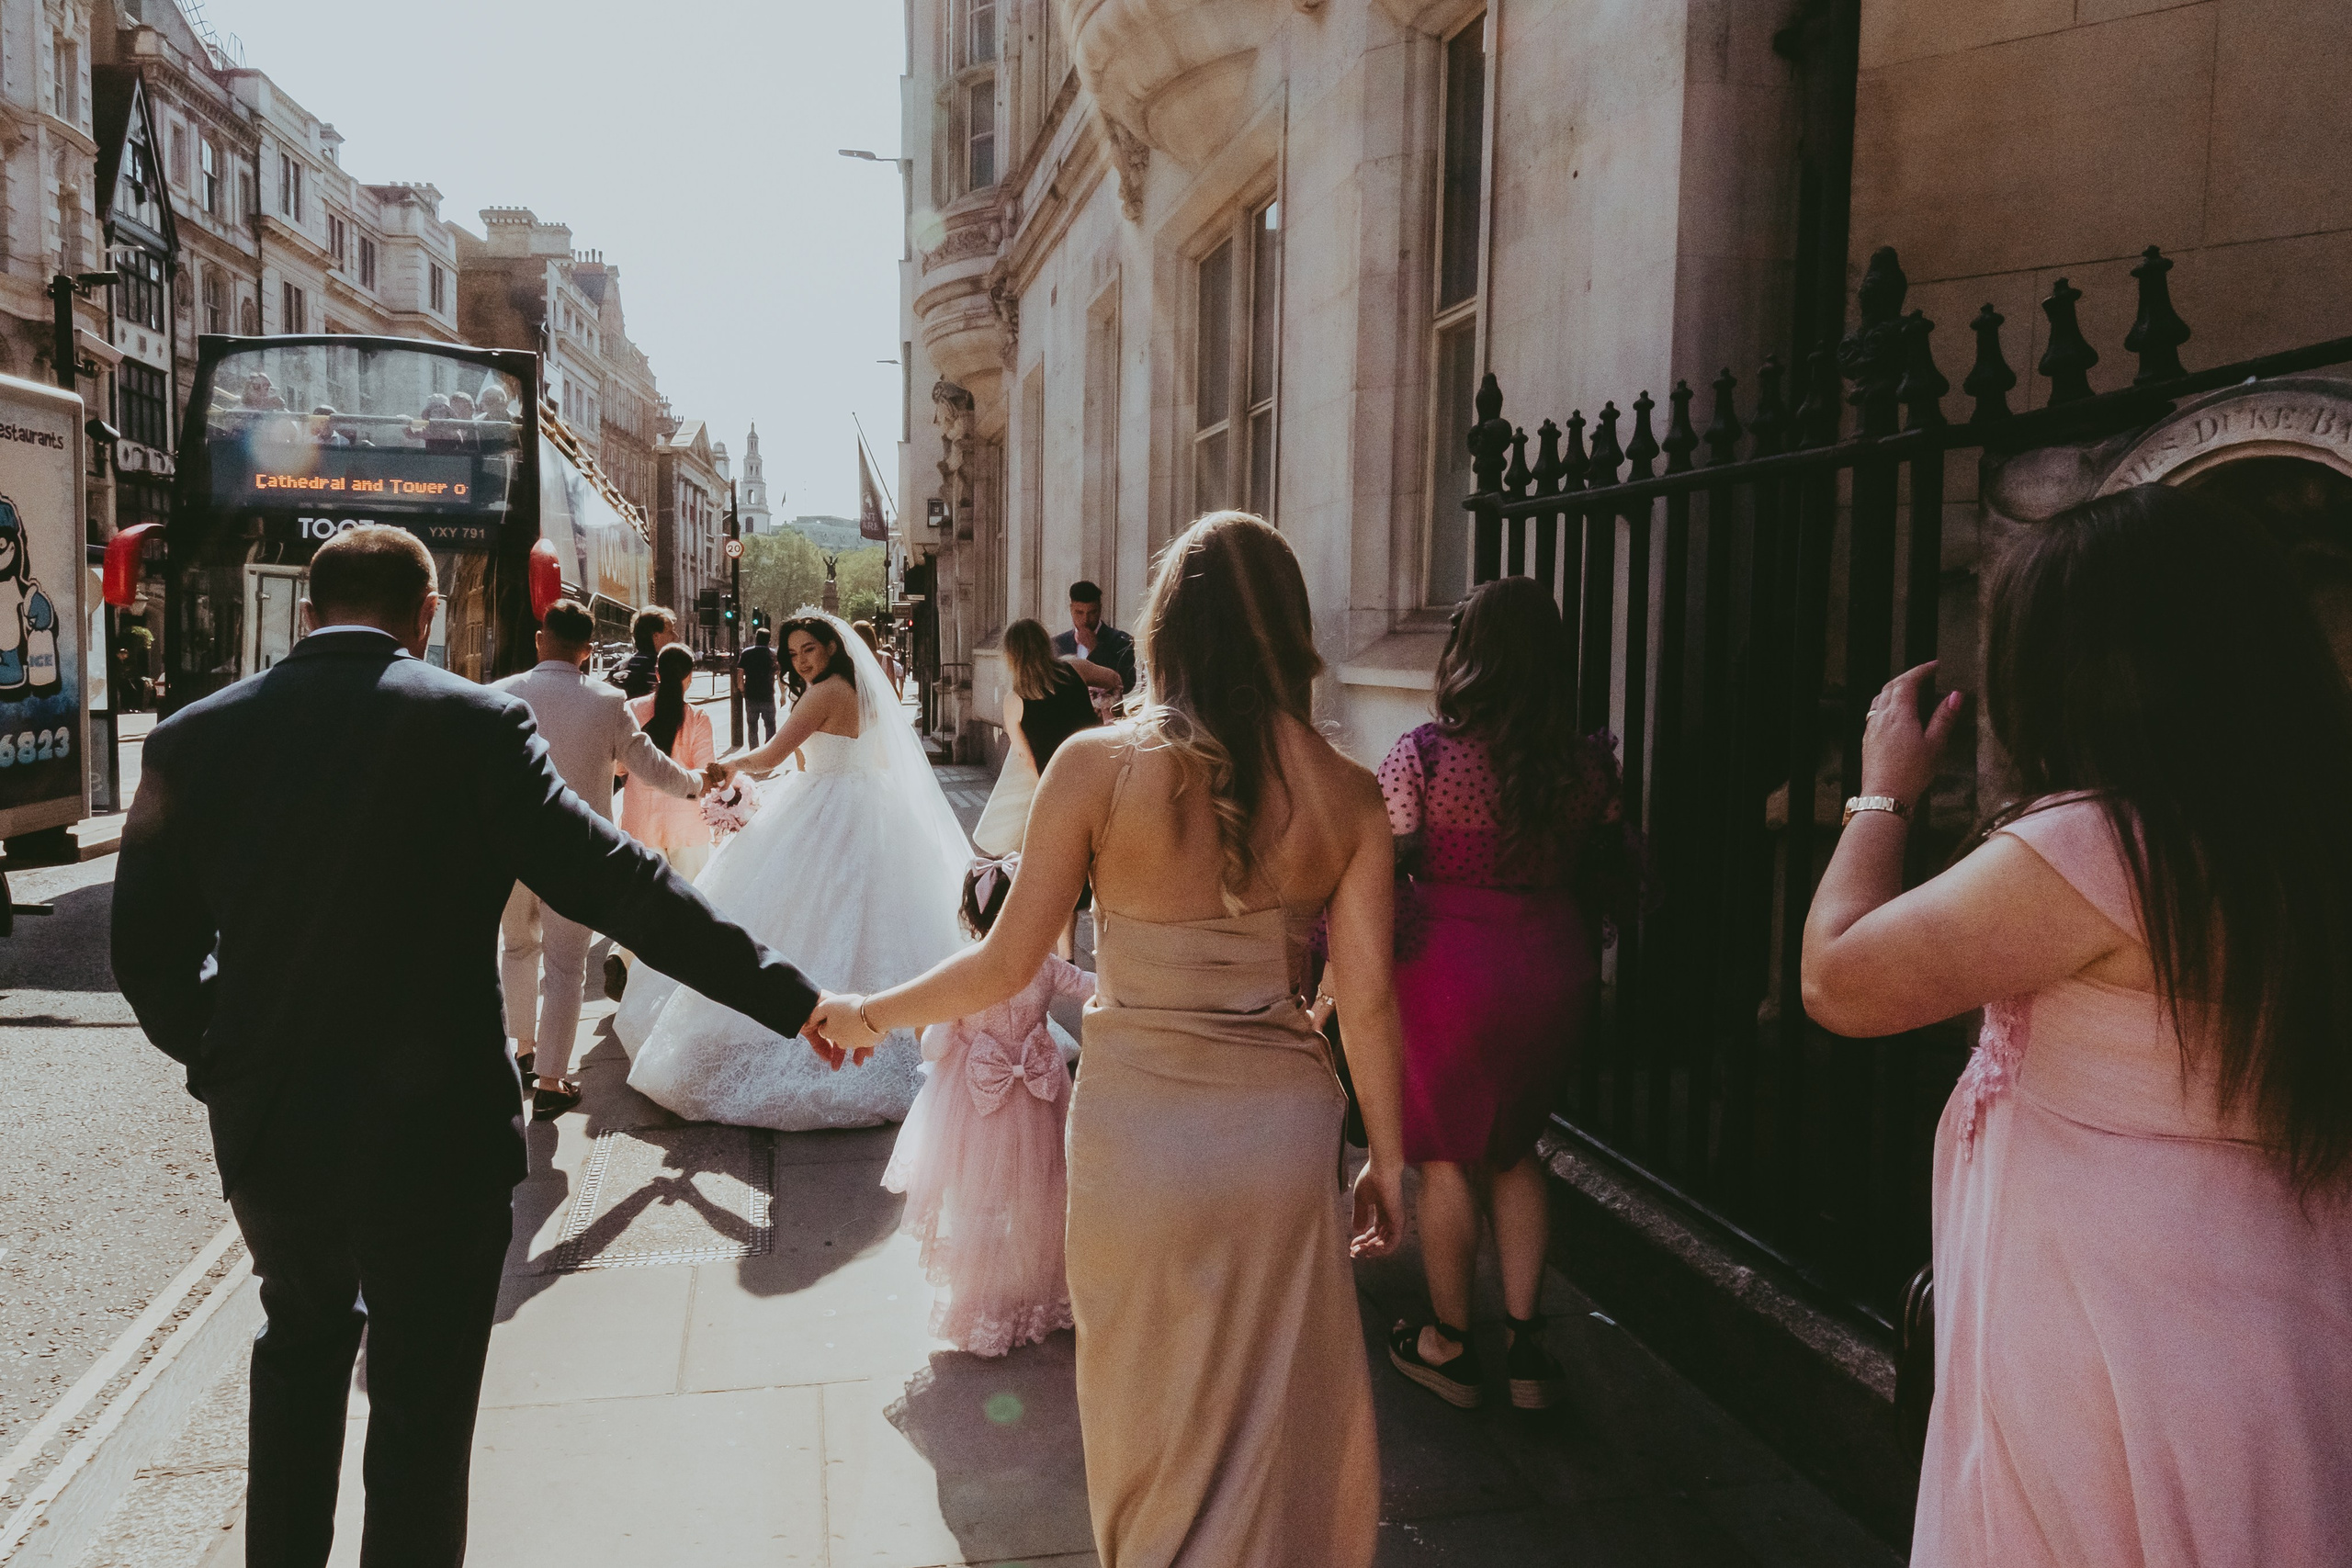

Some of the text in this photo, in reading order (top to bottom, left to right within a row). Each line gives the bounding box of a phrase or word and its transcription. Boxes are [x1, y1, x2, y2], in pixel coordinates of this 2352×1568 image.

[254, 473, 468, 495] Cathedral and Tower o
[428, 526, 485, 539] YXY 791
[727, 545, 741, 553] 20
[29, 653, 53, 668] ICE
[0, 726, 70, 768] 6823
